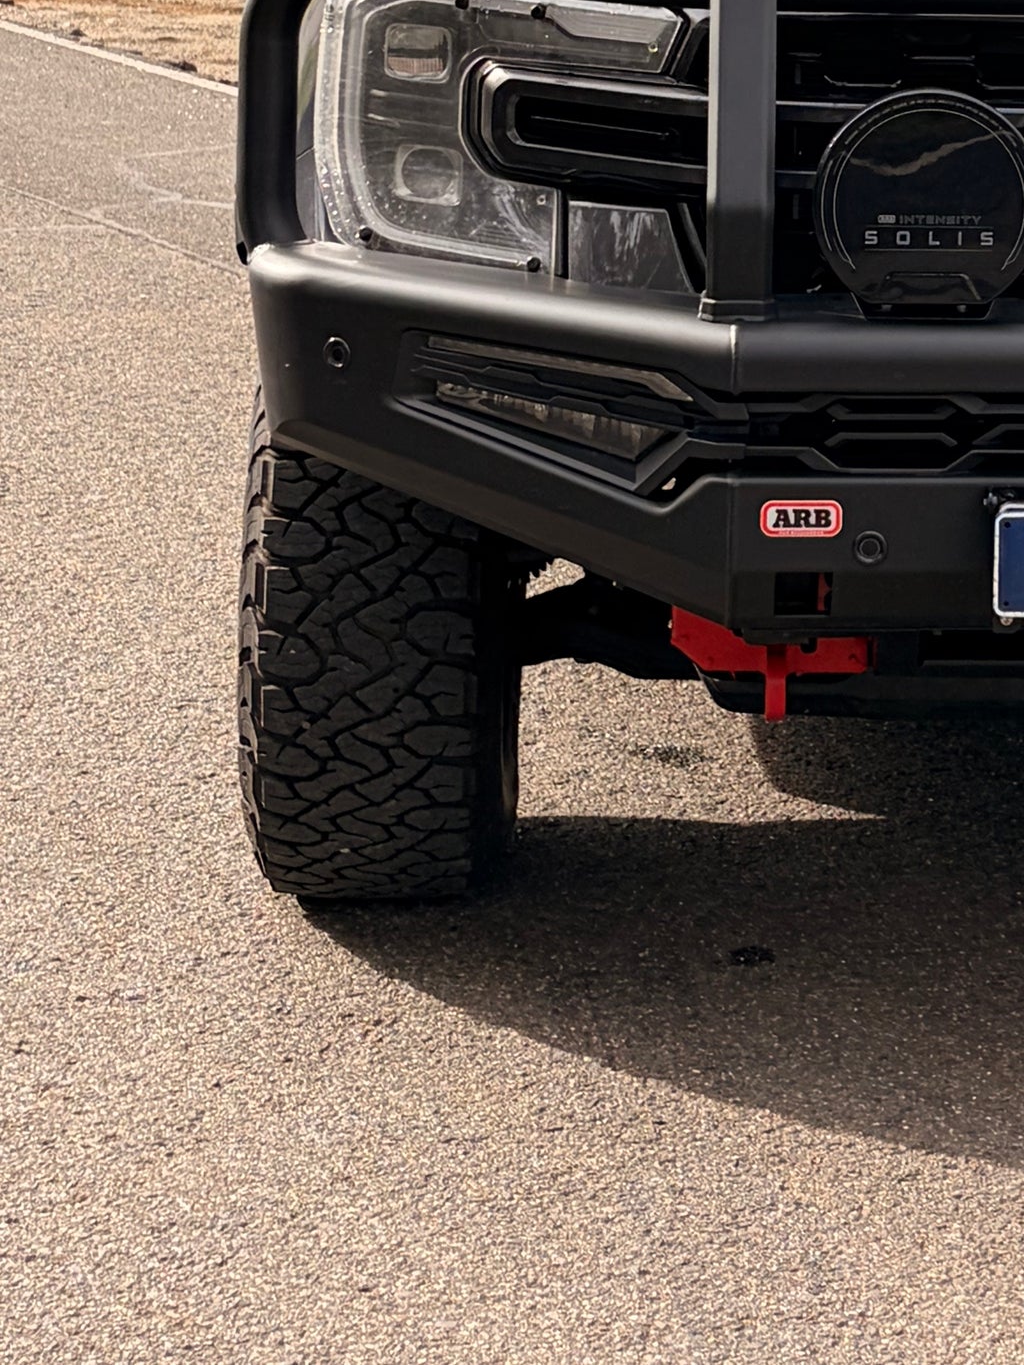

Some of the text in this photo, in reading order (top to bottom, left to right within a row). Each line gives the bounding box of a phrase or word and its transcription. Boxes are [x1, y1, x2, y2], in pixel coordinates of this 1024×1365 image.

[899, 215, 981, 225] INTENSITY
[864, 231, 994, 246] SOLIS
[772, 508, 832, 528] ARB
